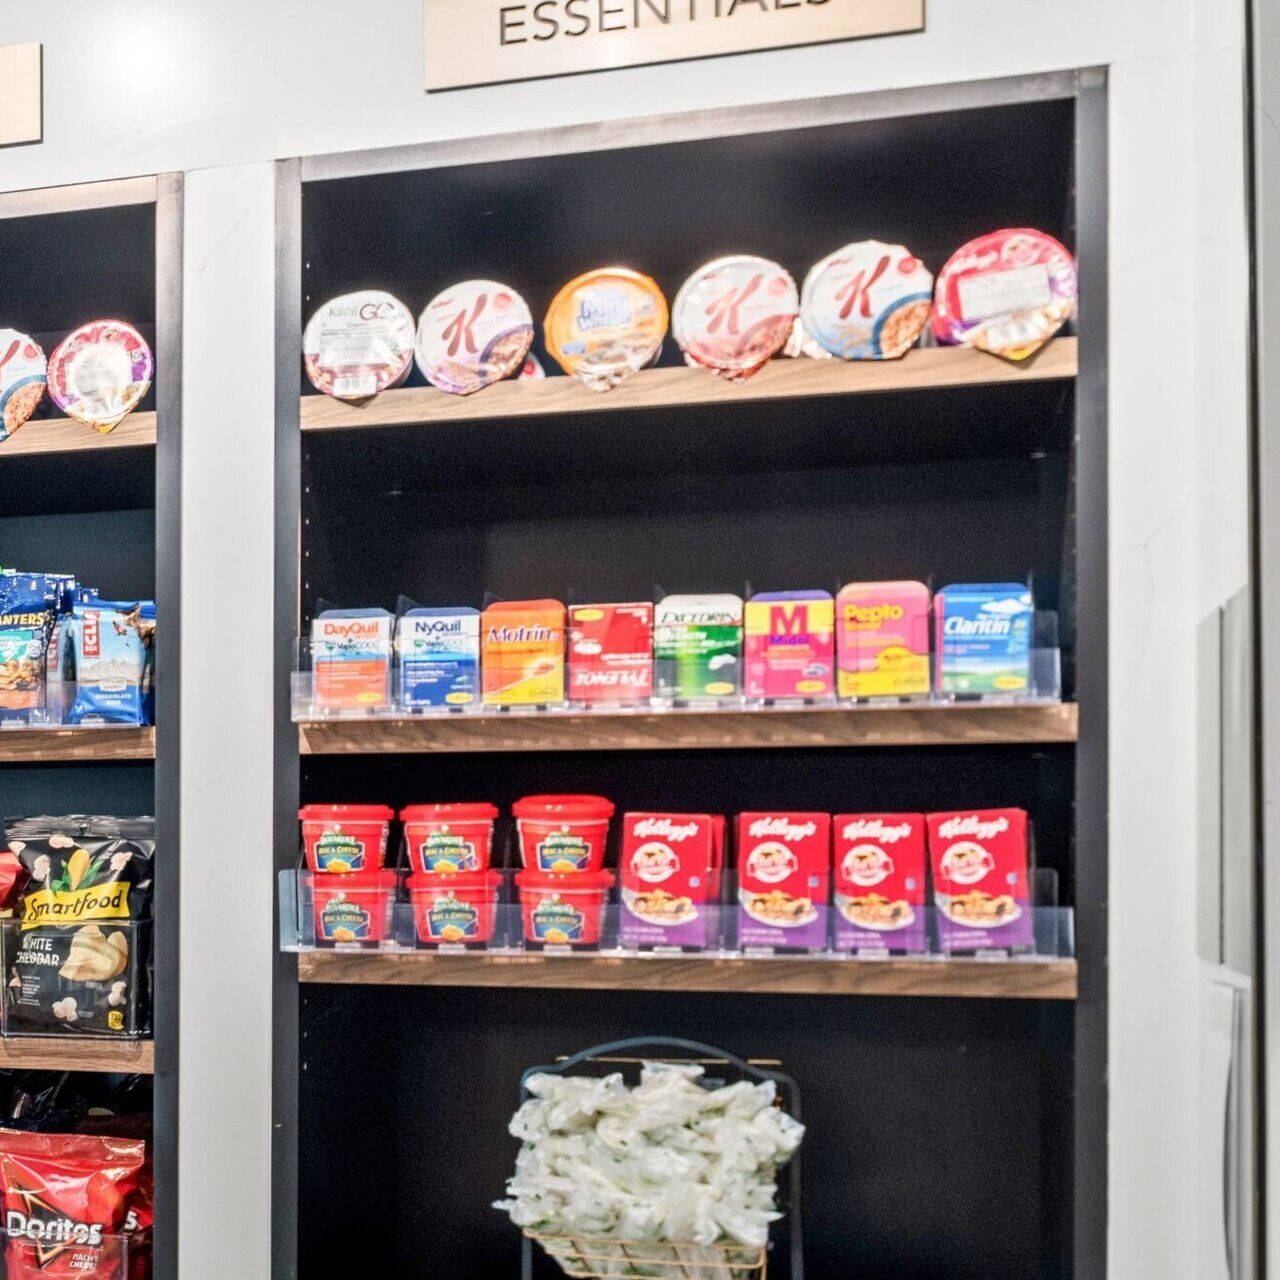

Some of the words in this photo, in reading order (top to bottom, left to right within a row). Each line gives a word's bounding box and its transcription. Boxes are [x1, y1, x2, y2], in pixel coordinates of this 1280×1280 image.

[499, 0, 829, 46] ESSENT
[835, 255, 892, 320] K
[705, 273, 762, 336] K
[441, 293, 489, 357] K
[324, 622, 379, 638] DayQuil
[415, 620, 461, 635] NyQuil
[771, 605, 808, 635] M
[945, 616, 1010, 634] Claritin
[486, 625, 558, 643] Motrin
[574, 669, 649, 689] TYLENOL
[633, 819, 699, 841] Kellogg's
[748, 816, 817, 841] Kellogg's
[842, 818, 912, 843] Kellogg's
[939, 816, 1009, 841] Kellogg's
[28, 892, 122, 921] Smartfood
[16, 950, 60, 966] CHEDDAR
[6, 1210, 104, 1246] Doritos
